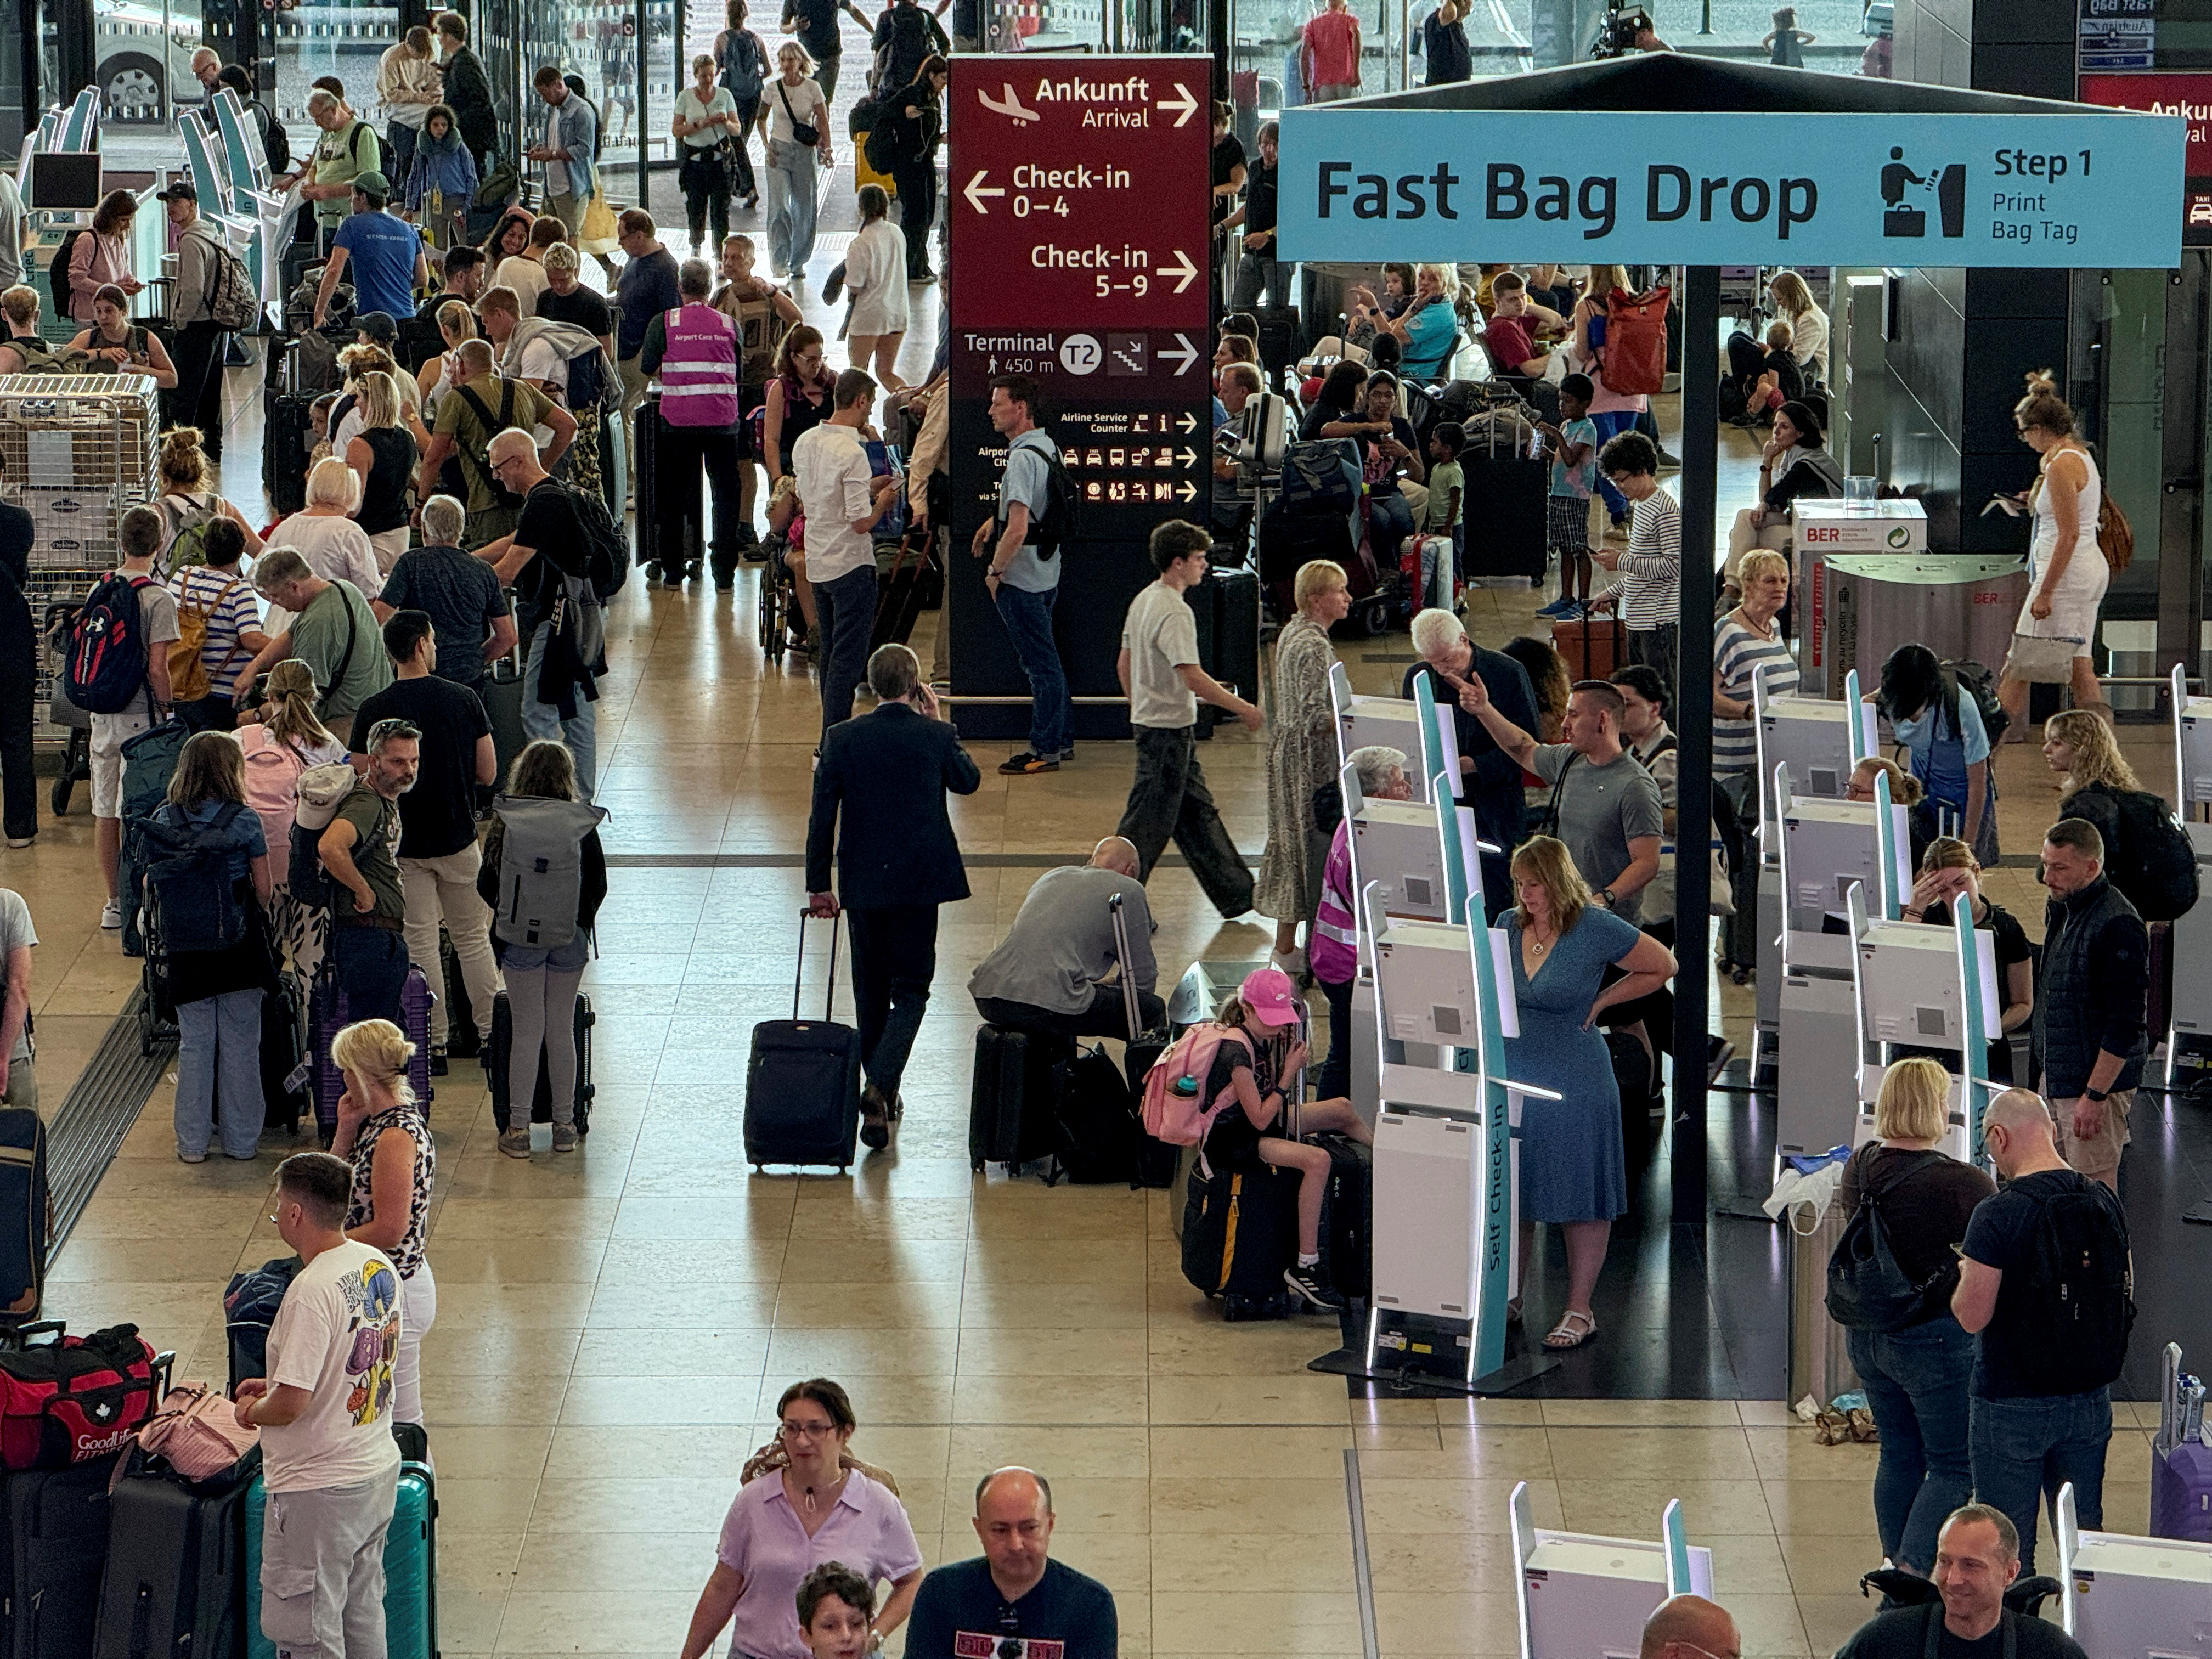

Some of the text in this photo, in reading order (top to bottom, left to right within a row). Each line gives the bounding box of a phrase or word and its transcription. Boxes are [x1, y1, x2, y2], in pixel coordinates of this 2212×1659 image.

[1036, 76, 1149, 101] Ankunft
[1082, 109, 1149, 127] Arrival
[2151, 100, 2212, 120] Anku
[1995, 149, 2091, 183] Step 1
[1013, 165, 1130, 188] Check-in
[1318, 161, 1818, 240] Fast Bag Drop
[1994, 193, 2046, 211] Print
[1993, 222, 2078, 245] Bag Tag
[1031, 245, 1148, 268] Check-in
[964, 333, 1096, 365] Terminal T2
[1005, 358, 1054, 373] 450 m
[1060, 413, 1128, 422] Airline Service
[1091, 424, 1128, 433] Counter
[978, 447, 1008, 458] Airpor
[994, 458, 1009, 467] Cit
[1807, 528, 1839, 542] BER
[1973, 592, 1998, 603] BER
[1839, 648, 1844, 657] zu
[1974, 1106, 1984, 1166] ck-in
[1490, 1104, 1503, 1271] Self Check-in
